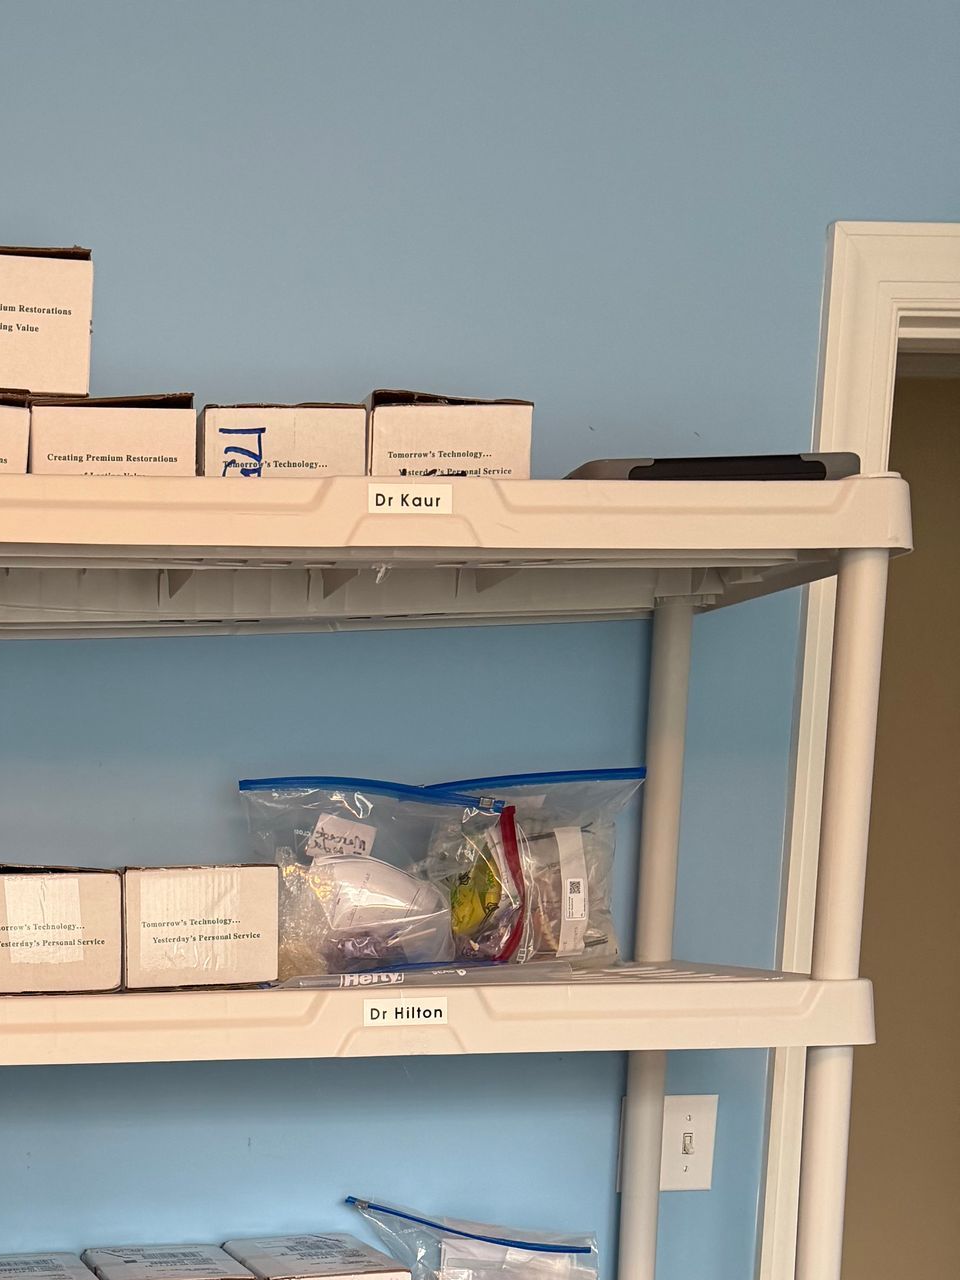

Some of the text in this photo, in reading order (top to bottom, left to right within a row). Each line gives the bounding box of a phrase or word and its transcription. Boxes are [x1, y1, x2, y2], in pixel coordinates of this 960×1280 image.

[18, 303, 72, 315] Restorations
[16, 322, 40, 332] Value
[47, 453, 178, 464] Creating Premium Restorations
[388, 450, 492, 460] Tomorrow's Technology...
[273, 460, 328, 470] Technology...
[482, 466, 512, 476] Service
[375, 493, 441, 507] Dr Kaur
[33, 923, 85, 932] Technology...
[141, 917, 241, 929] Tomorrow's Technology...
[42, 938, 76, 947] Personal
[77, 938, 105, 946] Service
[152, 931, 261, 944] Yesterday's Personal Service
[370, 1006, 443, 1020] Dr Hilton
